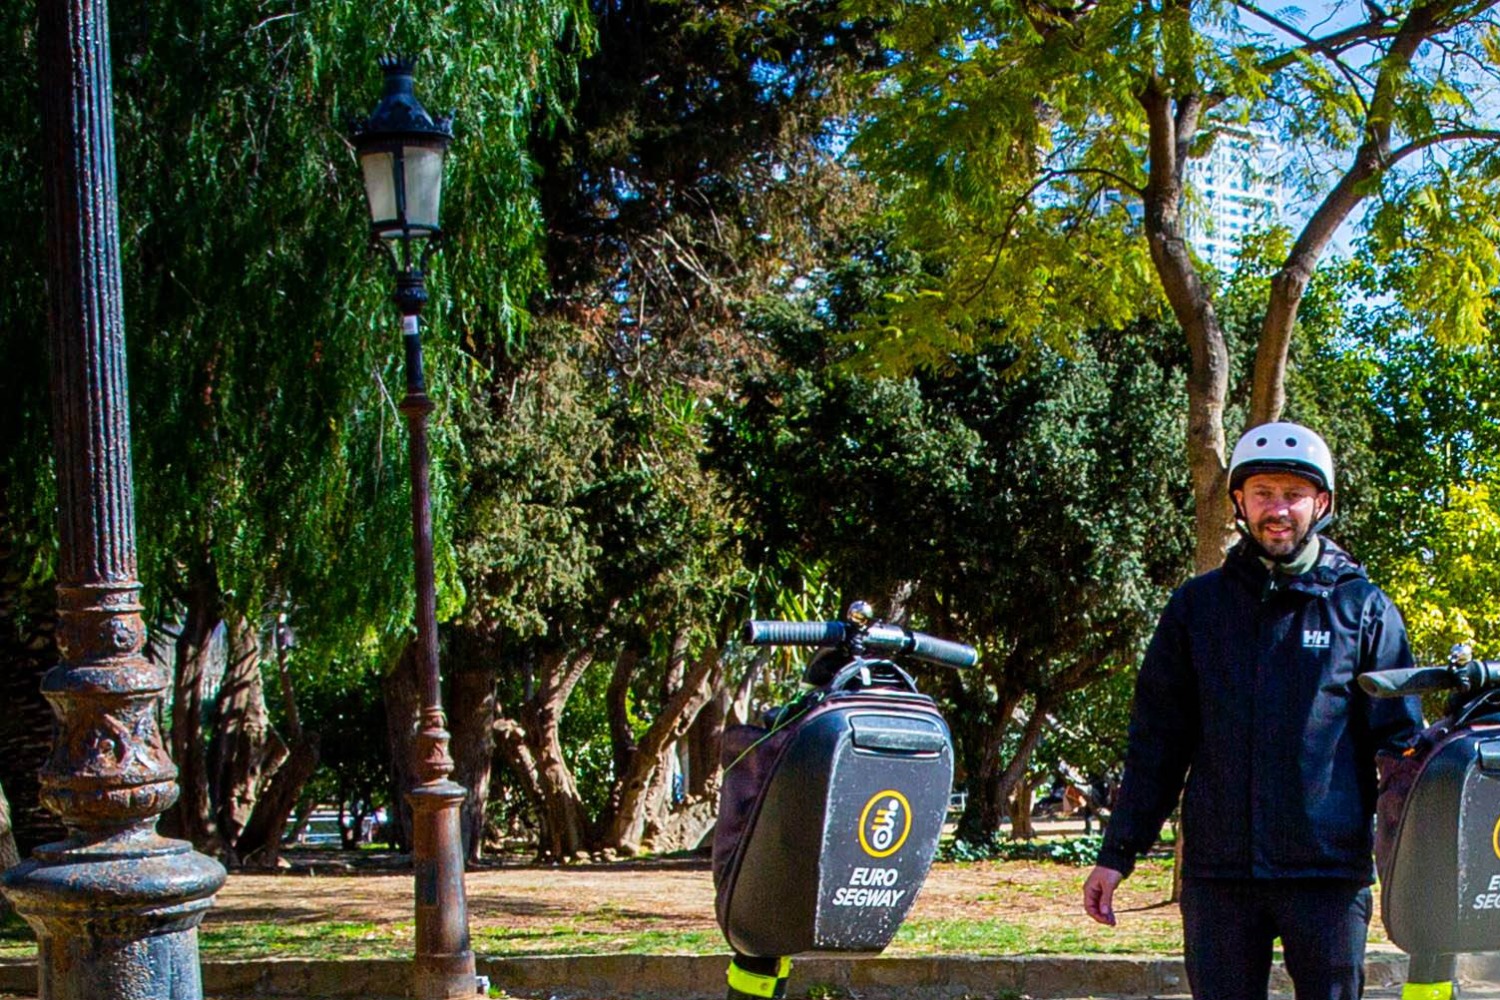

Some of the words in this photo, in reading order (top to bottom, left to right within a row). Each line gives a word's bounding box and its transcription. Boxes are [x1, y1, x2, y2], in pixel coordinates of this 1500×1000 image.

[1303, 630, 1330, 645] HH
[849, 867, 899, 887] EURO
[832, 887, 906, 907] SEGWAY
